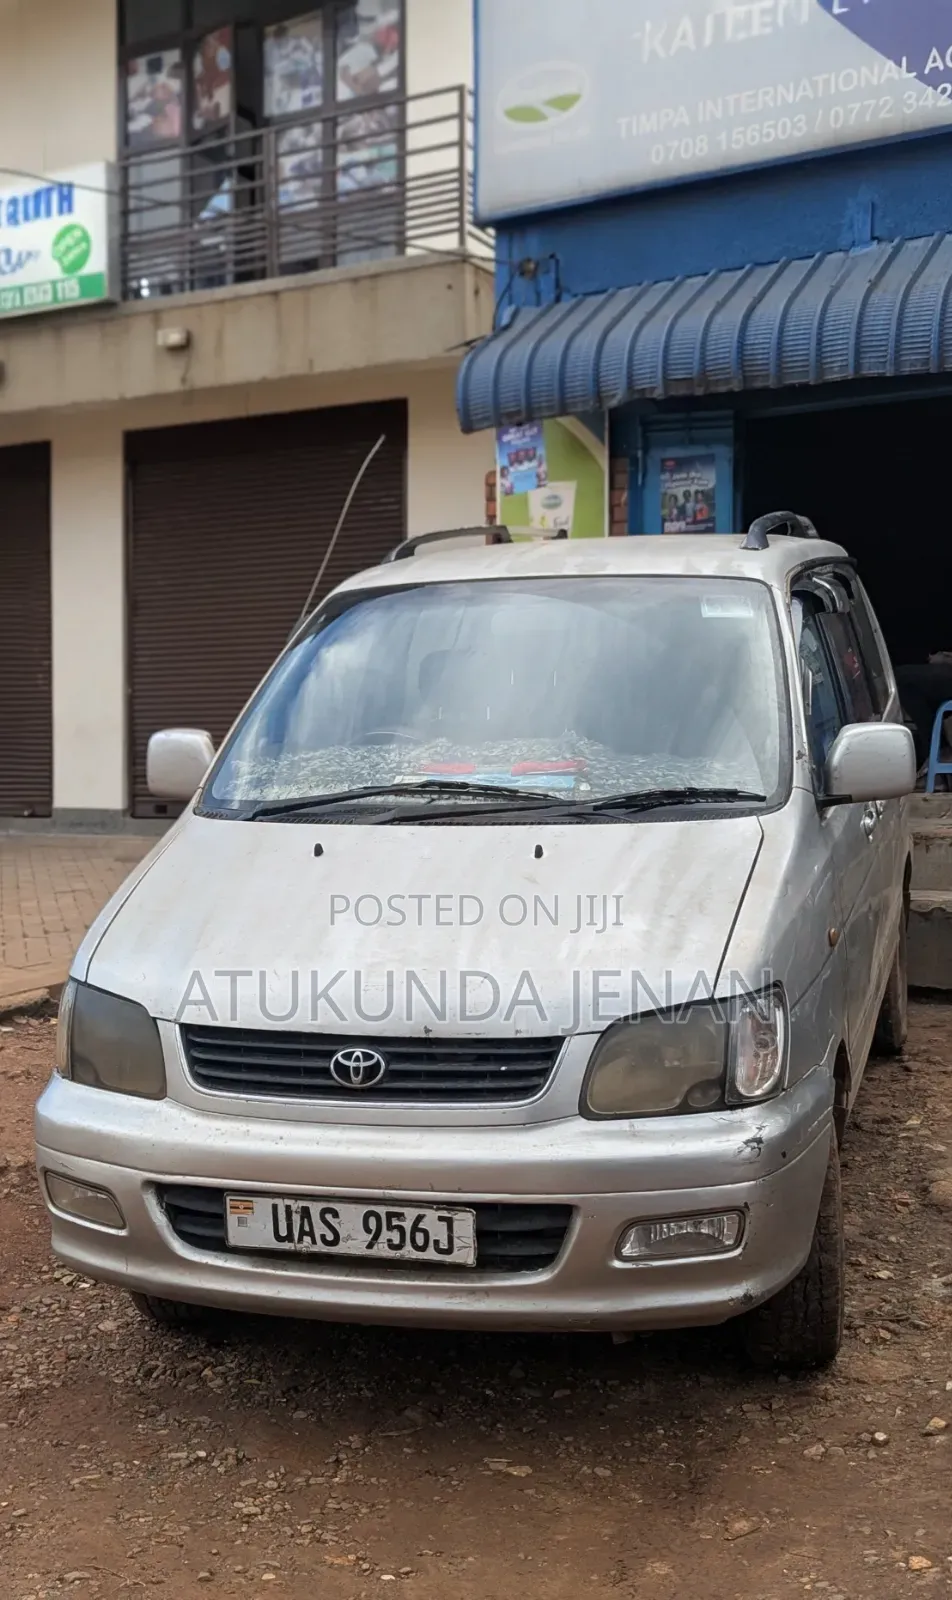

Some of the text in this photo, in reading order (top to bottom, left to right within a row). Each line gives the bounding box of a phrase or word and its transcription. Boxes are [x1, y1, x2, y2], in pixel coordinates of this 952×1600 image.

[616, 105, 691, 140] TIMPA
[698, 56, 917, 122] INTERNATIONAL
[652, 134, 709, 165] 0708
[716, 114, 807, 151] 156503
[830, 96, 893, 129] 0772
[271, 1203, 454, 1256] UAS 956J
